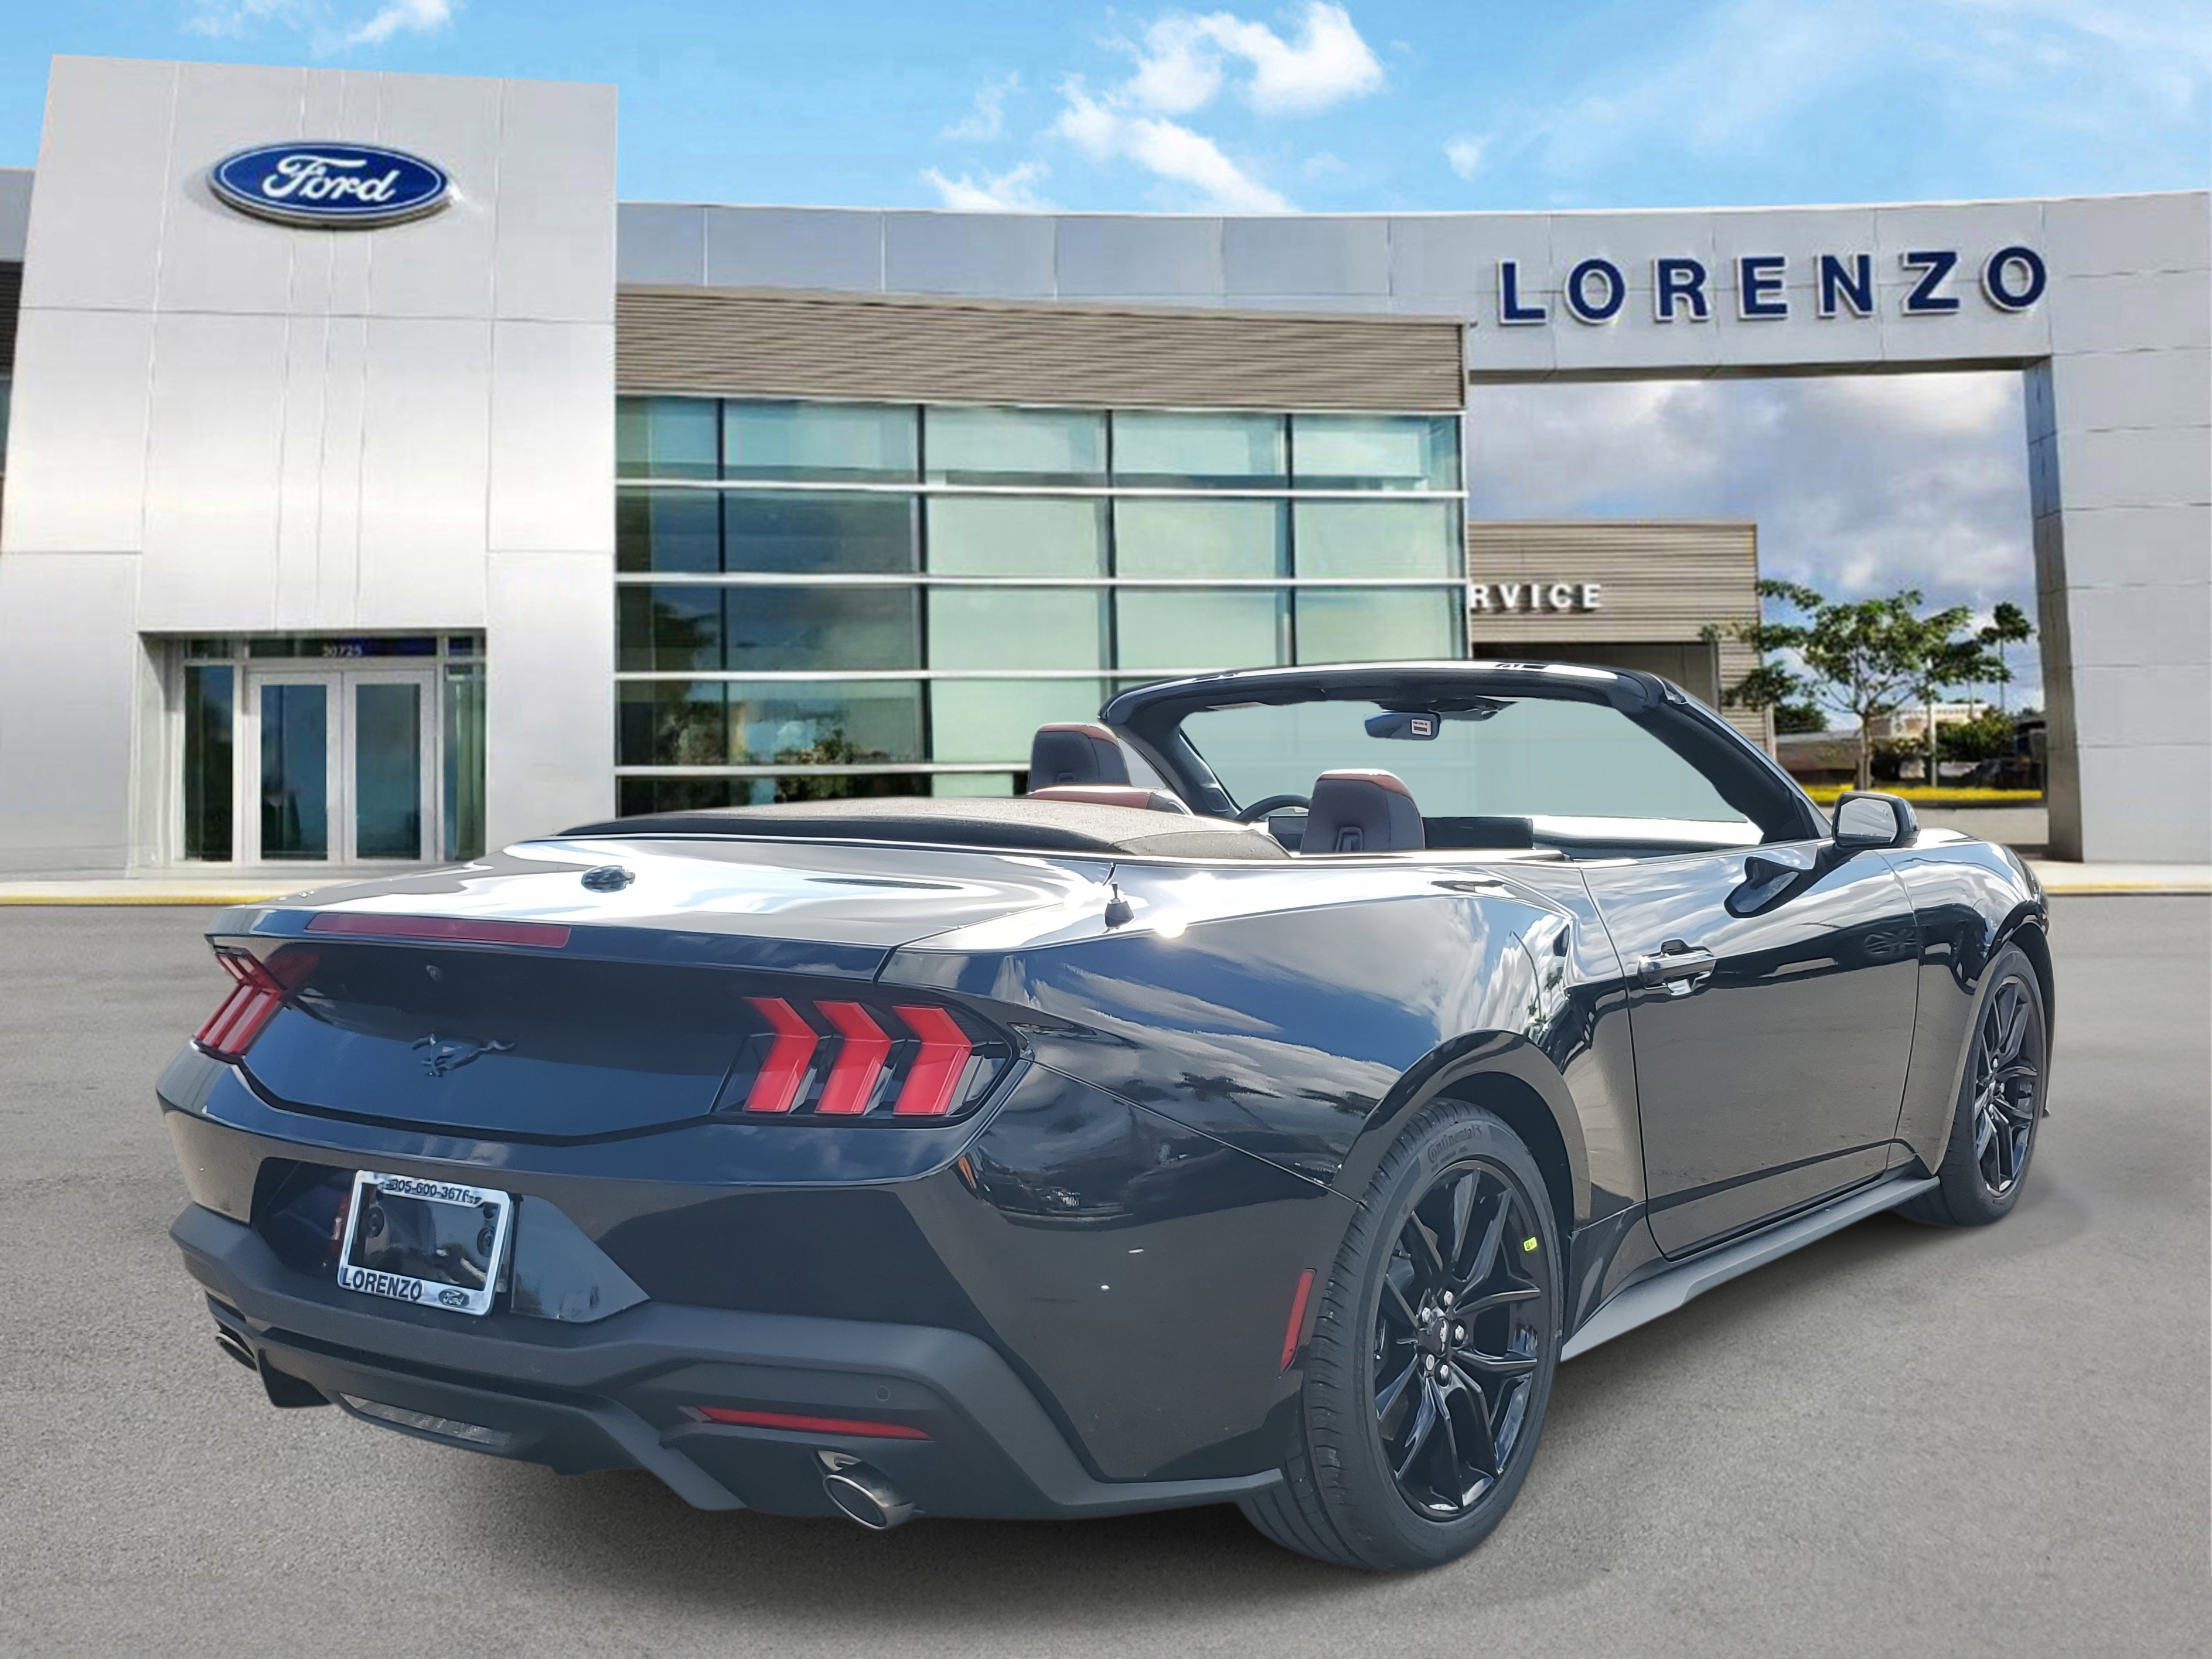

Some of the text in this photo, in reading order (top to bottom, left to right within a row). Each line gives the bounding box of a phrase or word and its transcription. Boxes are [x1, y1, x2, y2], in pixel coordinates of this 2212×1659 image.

[262, 155, 400, 202] Ford
[1498, 246, 2048, 324] LORENZO
[342, 1266, 424, 1302] LORENZO
